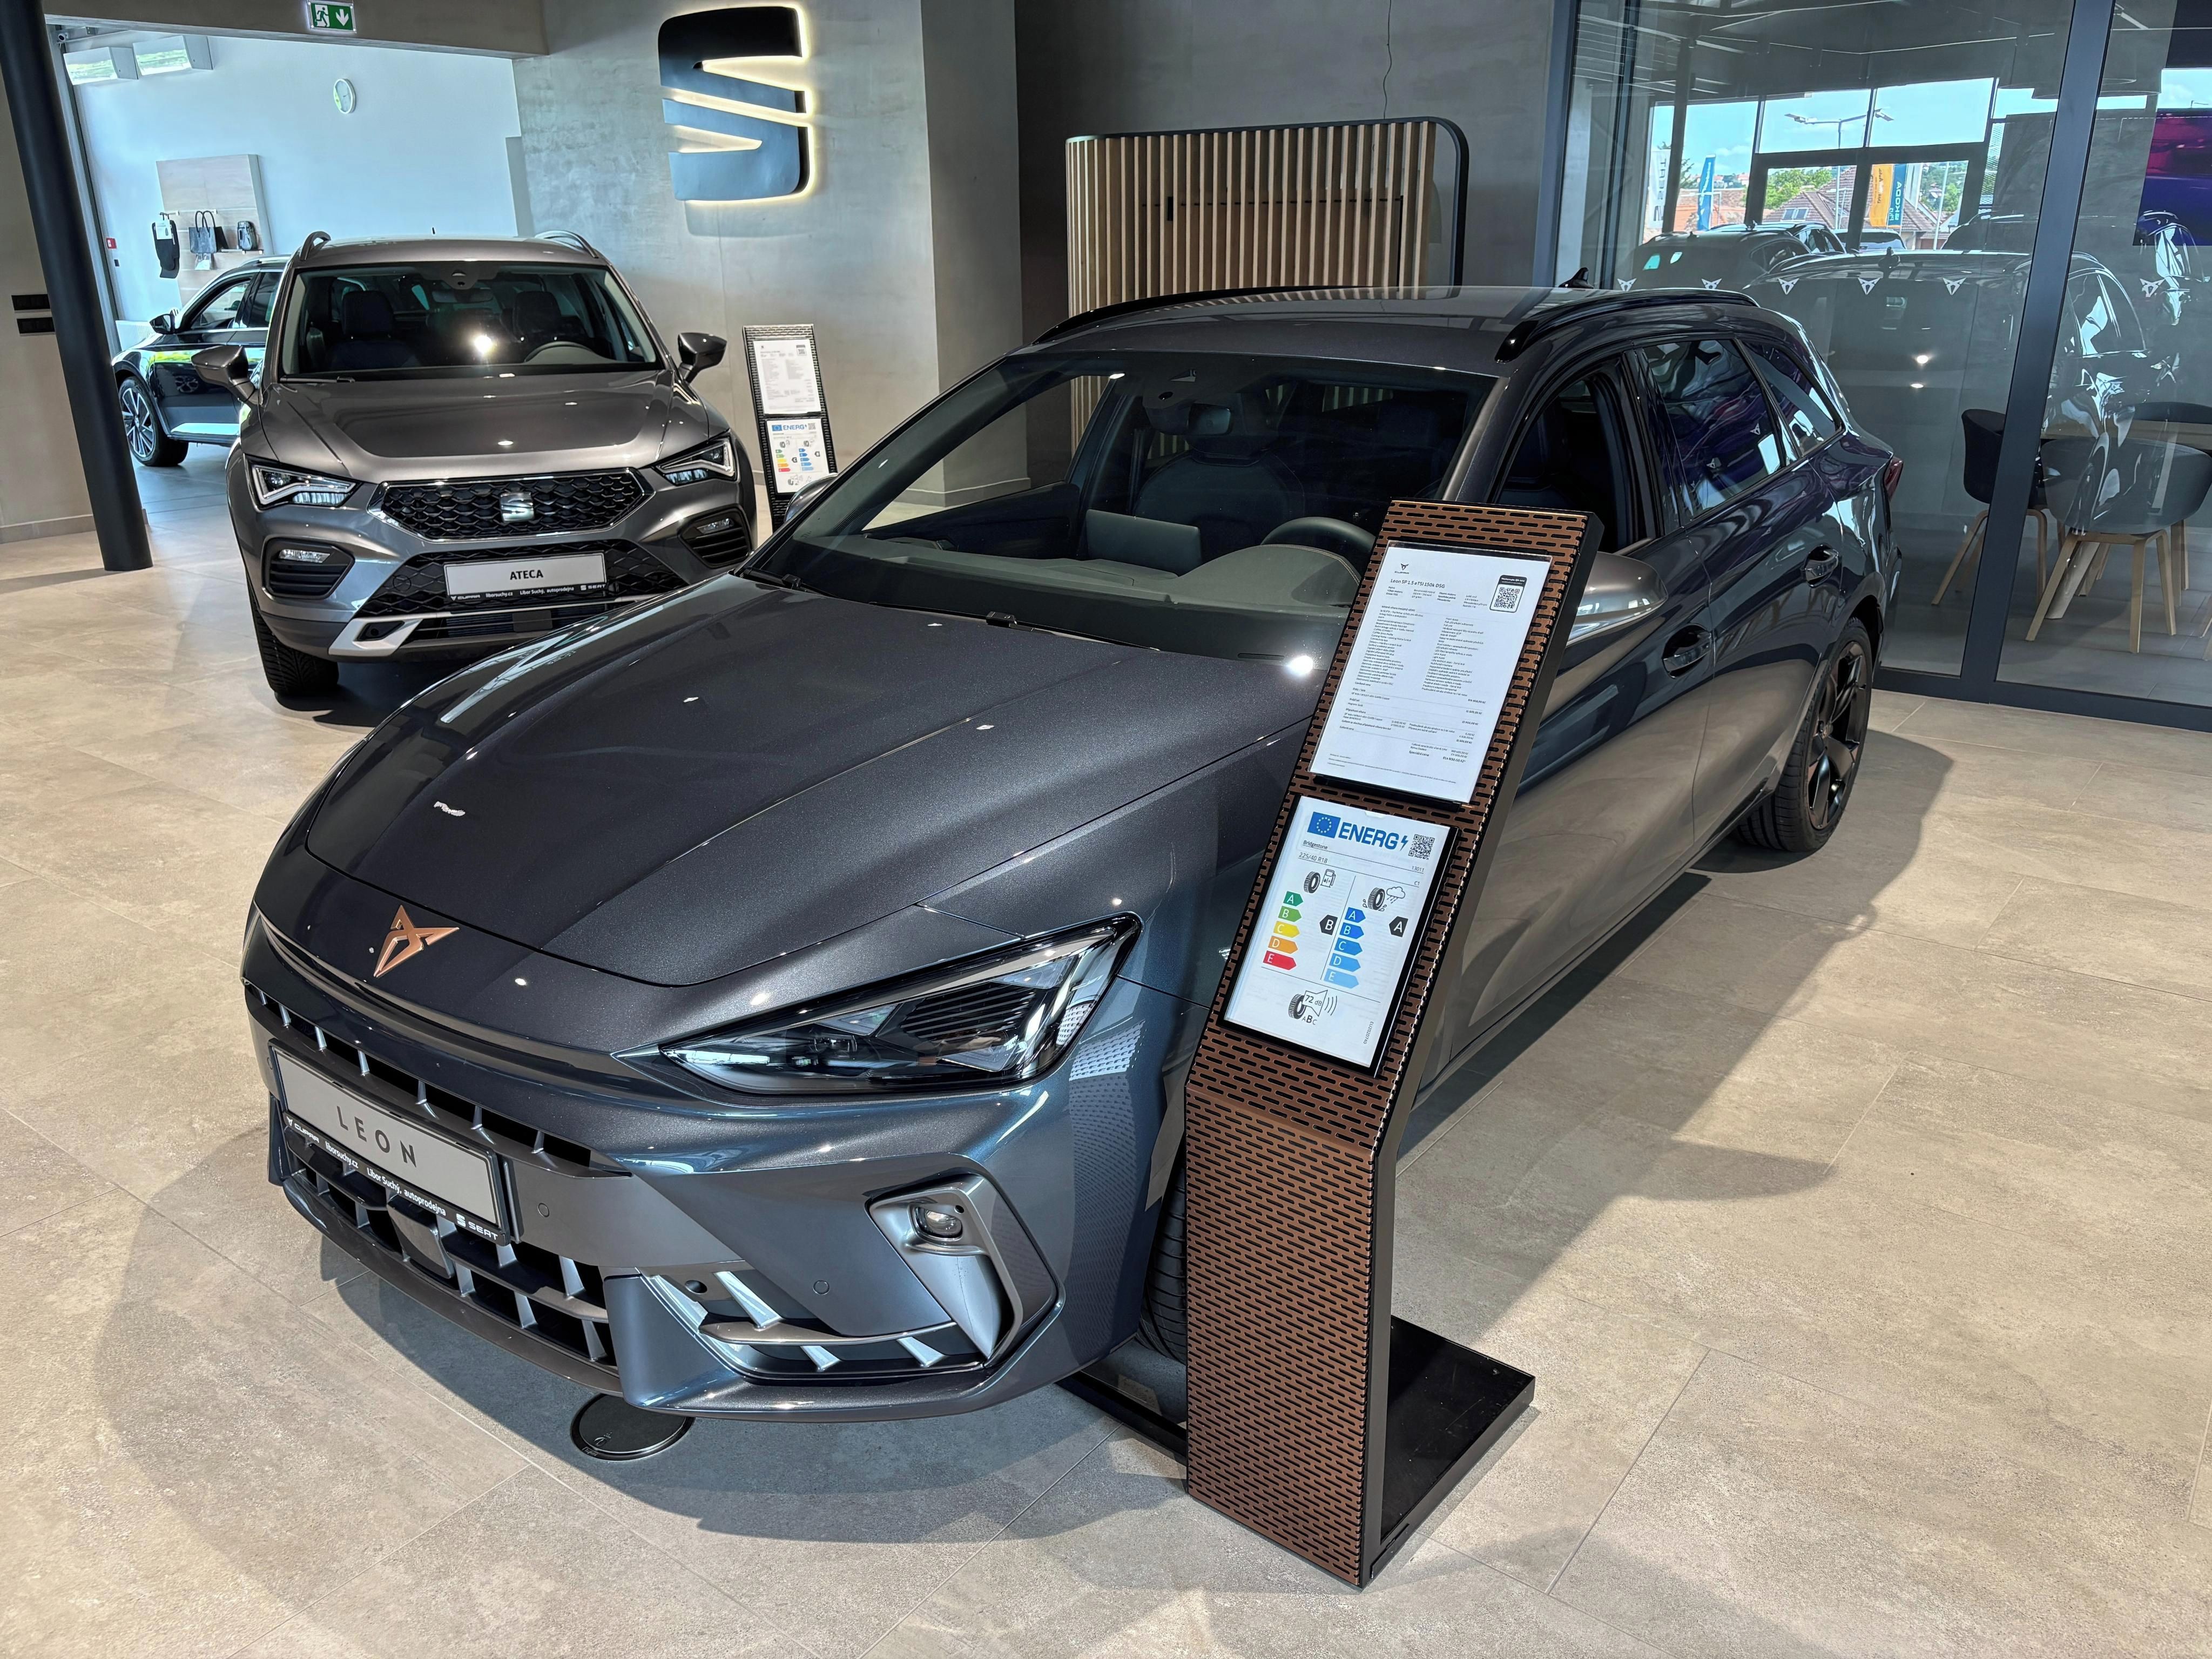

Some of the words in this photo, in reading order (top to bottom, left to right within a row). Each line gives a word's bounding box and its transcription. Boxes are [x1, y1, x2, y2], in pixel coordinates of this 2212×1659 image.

[510, 570, 543, 580] ATECA
[1338, 822, 1399, 849] ENERG
[1303, 840, 1327, 849] Bridgestone
[1299, 852, 1317, 861] 225/40
[1287, 894, 1293, 904] A
[1282, 909, 1289, 918] B
[1348, 911, 1355, 920] A
[1277, 924, 1284, 934] C
[1325, 919, 1333, 930] B
[1393, 921, 1402, 933] A
[1344, 925, 1351, 935] B
[1272, 939, 1279, 948] D
[1339, 941, 1346, 950] C
[1267, 953, 1274, 963] E
[1333, 956, 1341, 965] D
[1328, 972, 1336, 981] E
[1305, 995, 1314, 1003] 72
[1306, 1015, 1313, 1023] B
[337, 1106, 416, 1168] LEON
[294, 1123, 319, 1143] CUPRA
[325, 1141, 359, 1168] liborsuchy.cz
[367, 1168, 381, 1182] Libor
[382, 1176, 402, 1194] Suchý,
[404, 1190, 446, 1216] autoprodejna
[468, 1222, 498, 1240] SEAT
